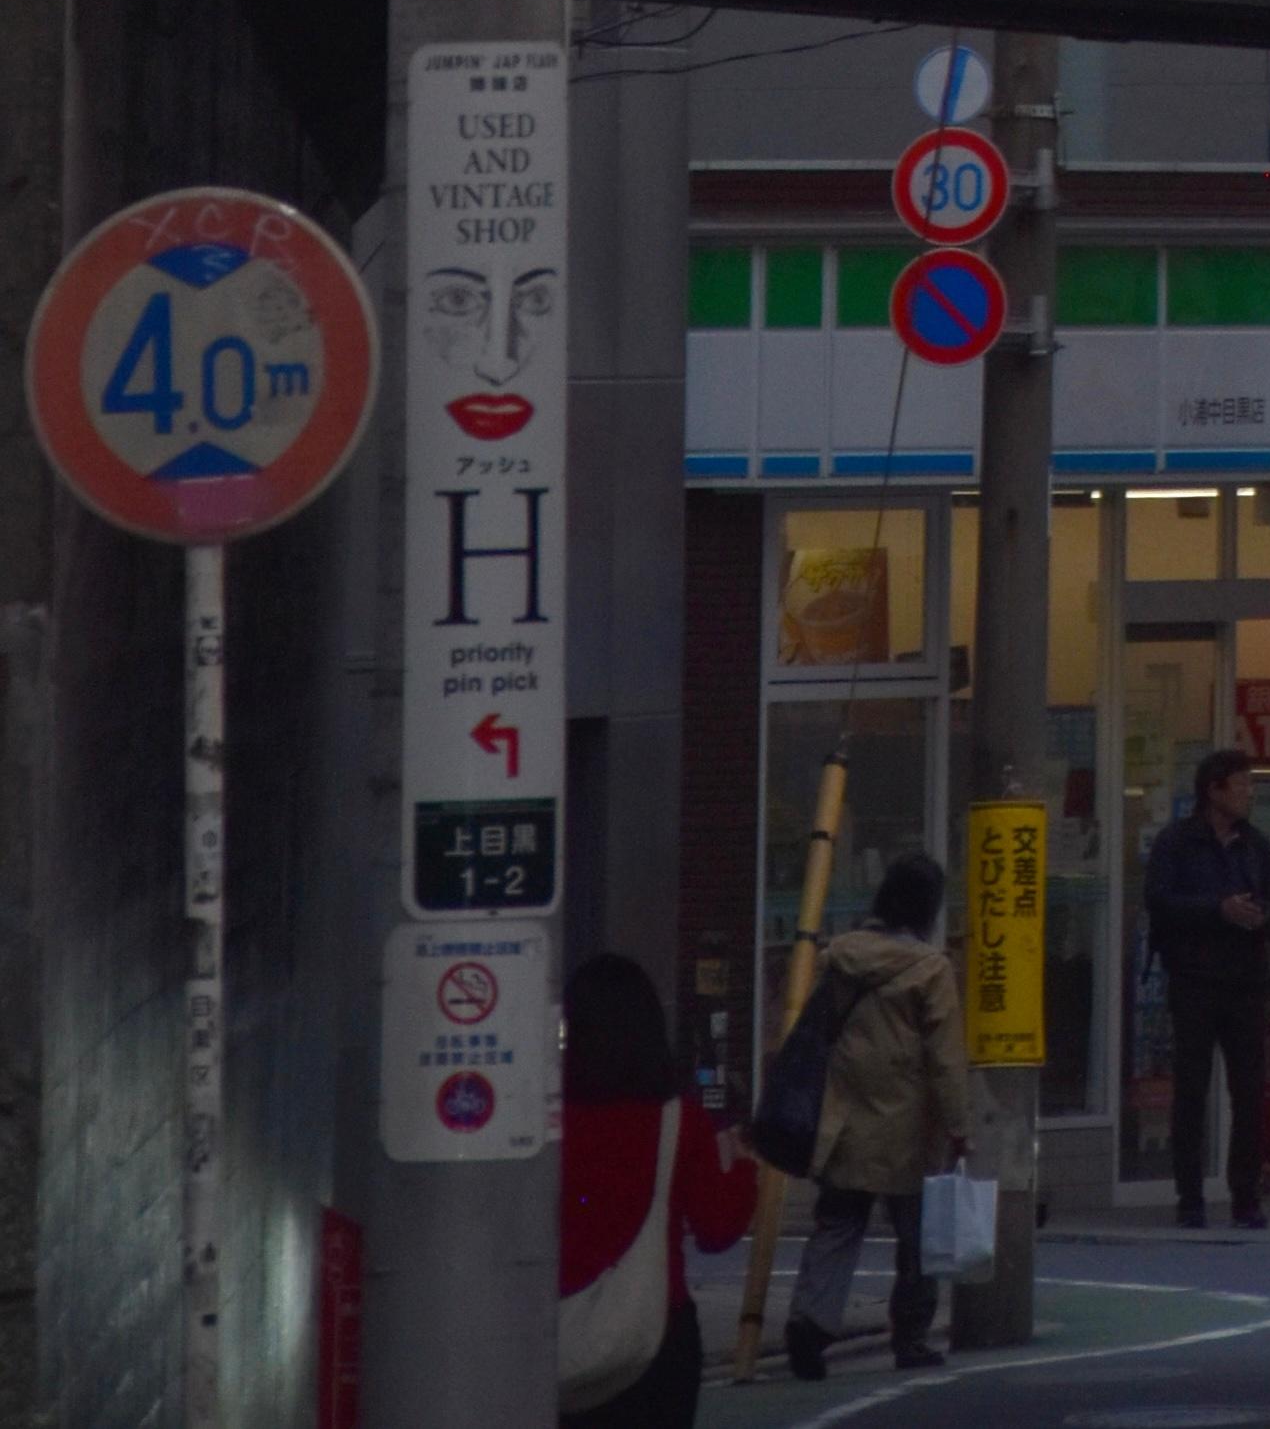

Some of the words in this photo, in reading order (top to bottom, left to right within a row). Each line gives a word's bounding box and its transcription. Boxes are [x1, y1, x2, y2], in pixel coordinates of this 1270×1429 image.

[458, 113, 536, 139] USED
[463, 148, 531, 174] AND
[429, 181, 554, 209] VINTAGE
[922, 163, 983, 212] 30
[456, 217, 536, 245] SHOP
[456, 456, 531, 476] アッシュ
[434, 488, 549, 625] H
[450, 642, 534, 666] priority
[443, 675, 483, 697] pin
[492, 672, 539, 694] pick
[444, 823, 537, 857] 上目黒
[459, 865, 526, 897] 1-2
[1012, 826, 1038, 918] 交差点
[978, 826, 1008, 1013] とびだし注意
